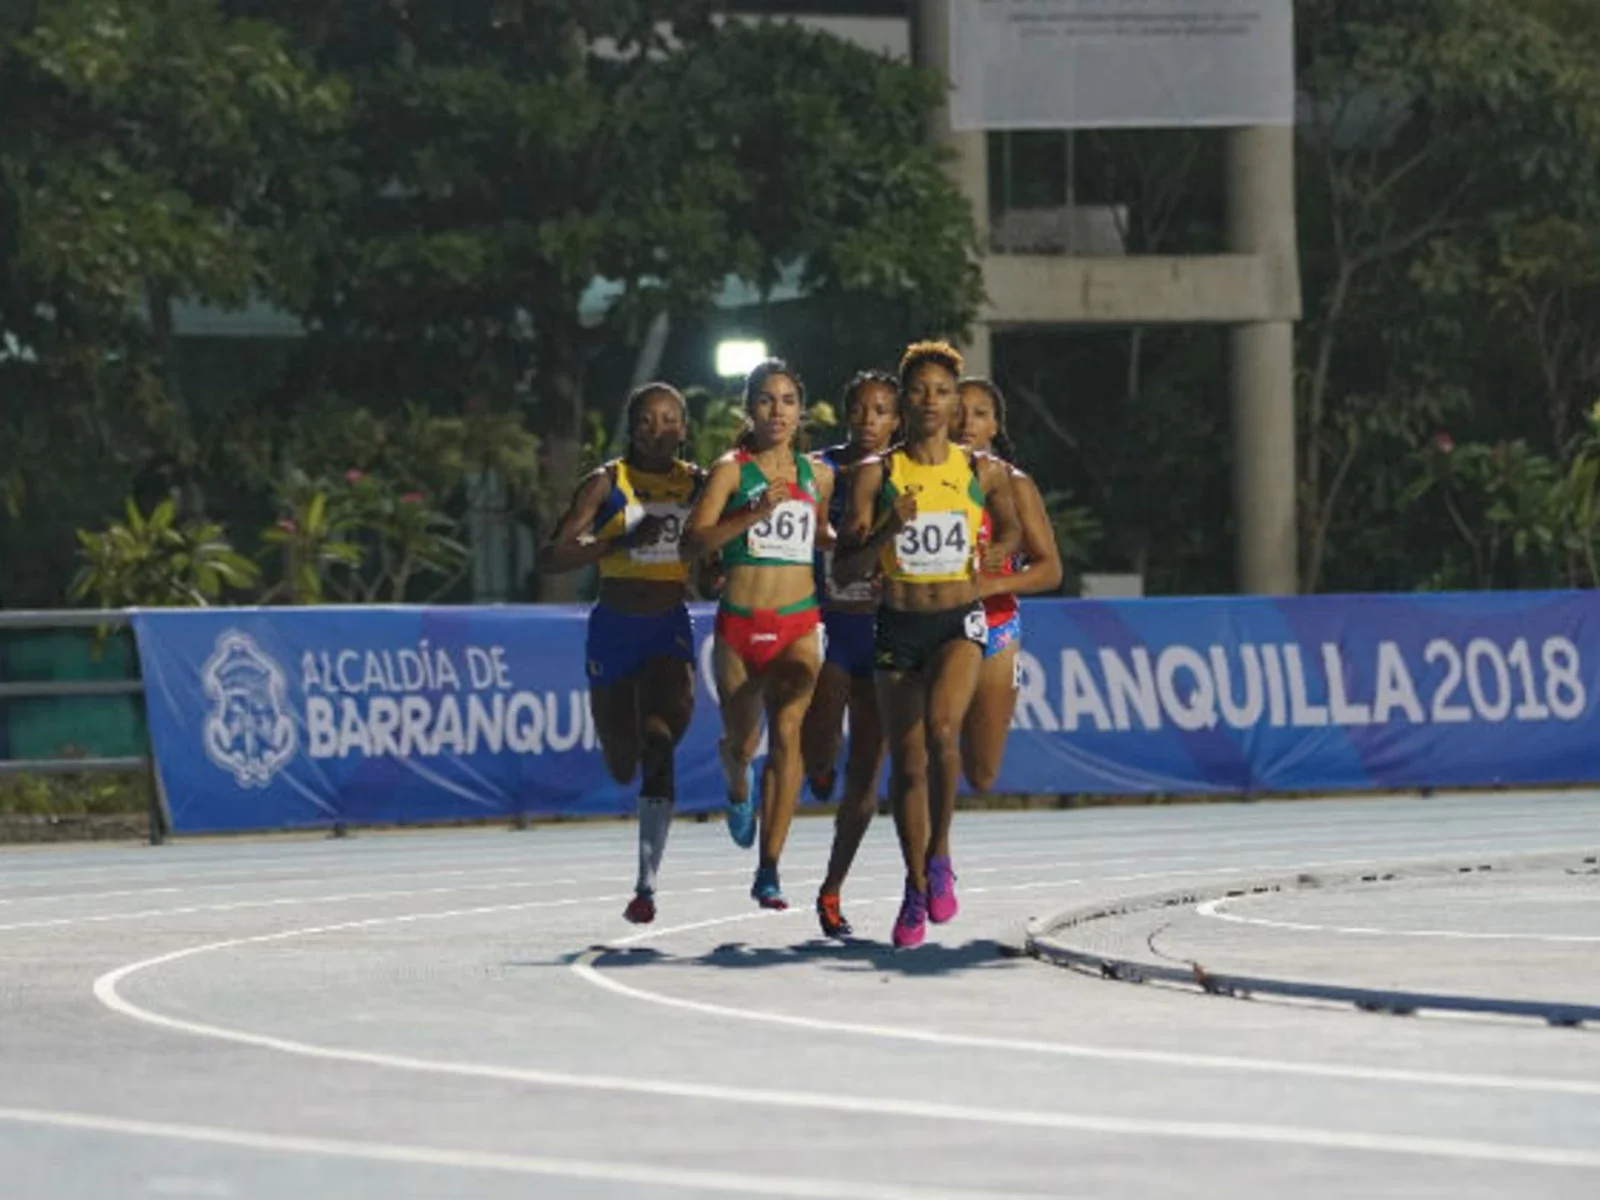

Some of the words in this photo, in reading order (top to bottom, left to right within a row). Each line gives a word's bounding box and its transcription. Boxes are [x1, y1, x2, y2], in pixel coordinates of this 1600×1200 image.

[900, 522, 966, 555] 304
[302, 639, 460, 693] ALCALDÍA
[467, 646, 512, 690] DE
[1009, 639, 1425, 733] RANQUILLA
[1425, 636, 1586, 722] 2018
[307, 687, 603, 758] BARRANQUI
